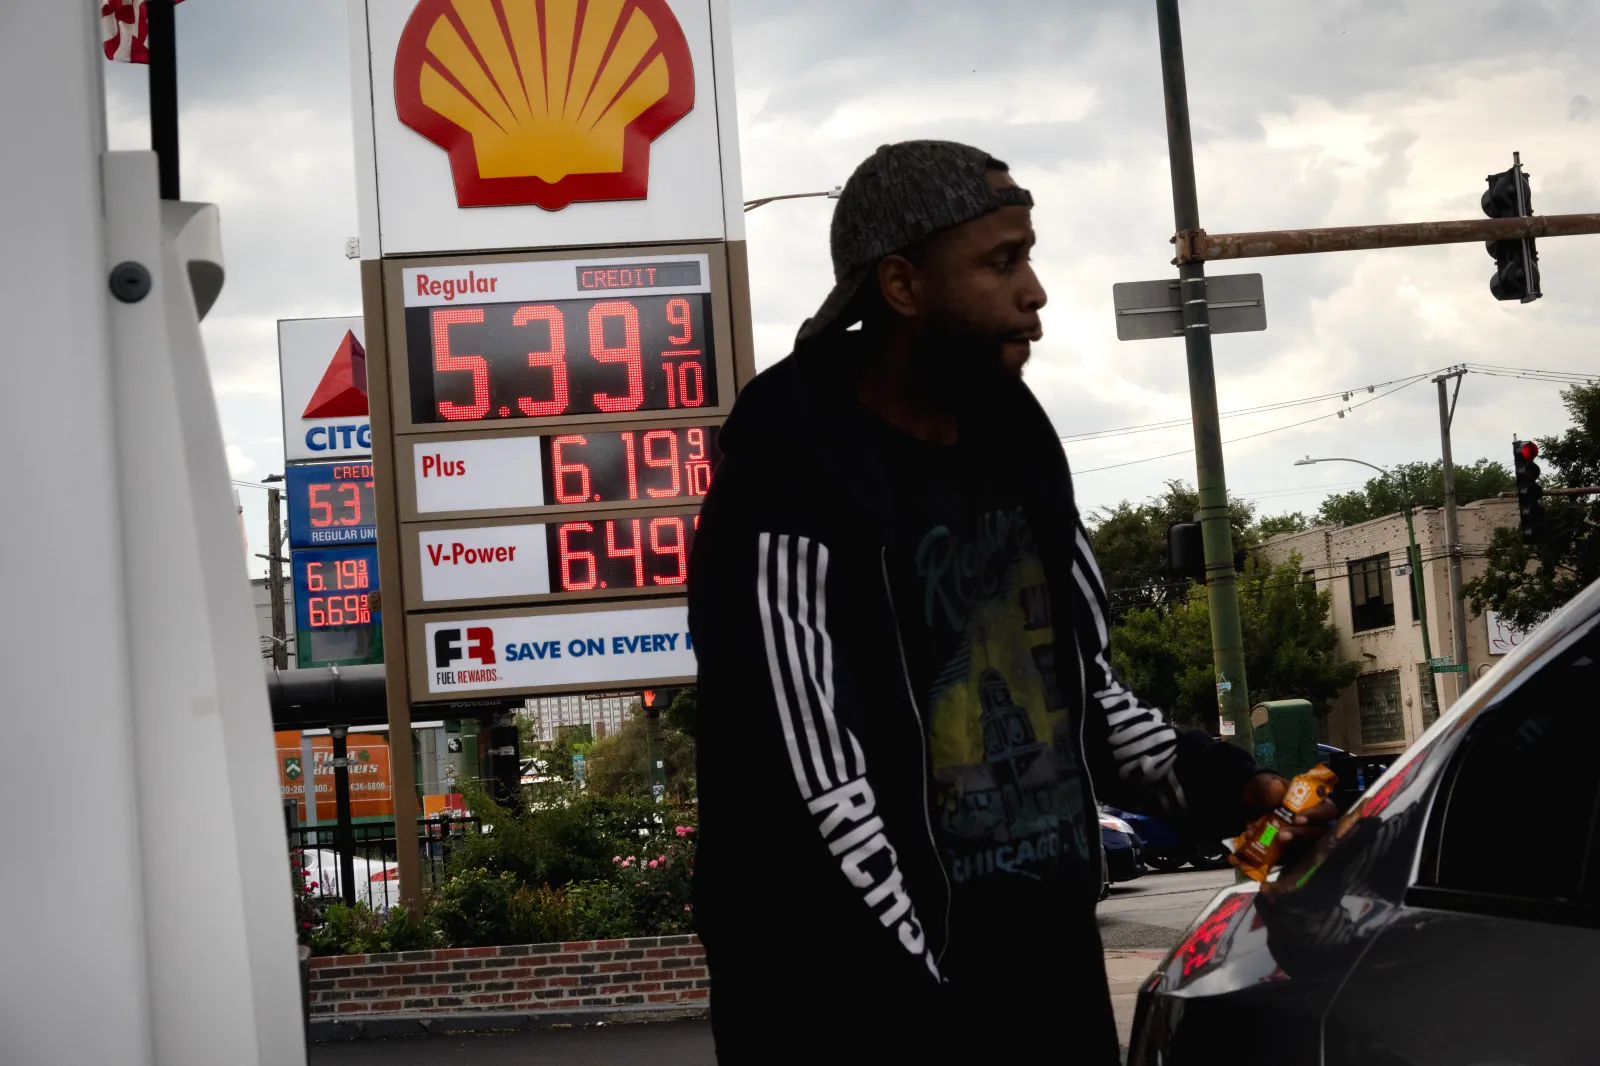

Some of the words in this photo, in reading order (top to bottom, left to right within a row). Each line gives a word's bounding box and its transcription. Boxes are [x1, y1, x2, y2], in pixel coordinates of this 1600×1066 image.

[416, 270, 498, 300] Regular
[582, 267, 657, 288] CREDIT
[422, 454, 466, 477] Plus
[312, 530, 357, 542] REGULAR
[427, 543, 516, 566] V-Power
[559, 517, 687, 591] 6.49
[505, 641, 561, 662] SAVE
[568, 638, 604, 657] ON
[612, 633, 679, 654] EVERY
[437, 671, 456, 685] FUEL
[457, 669, 497, 683] REWARDS
